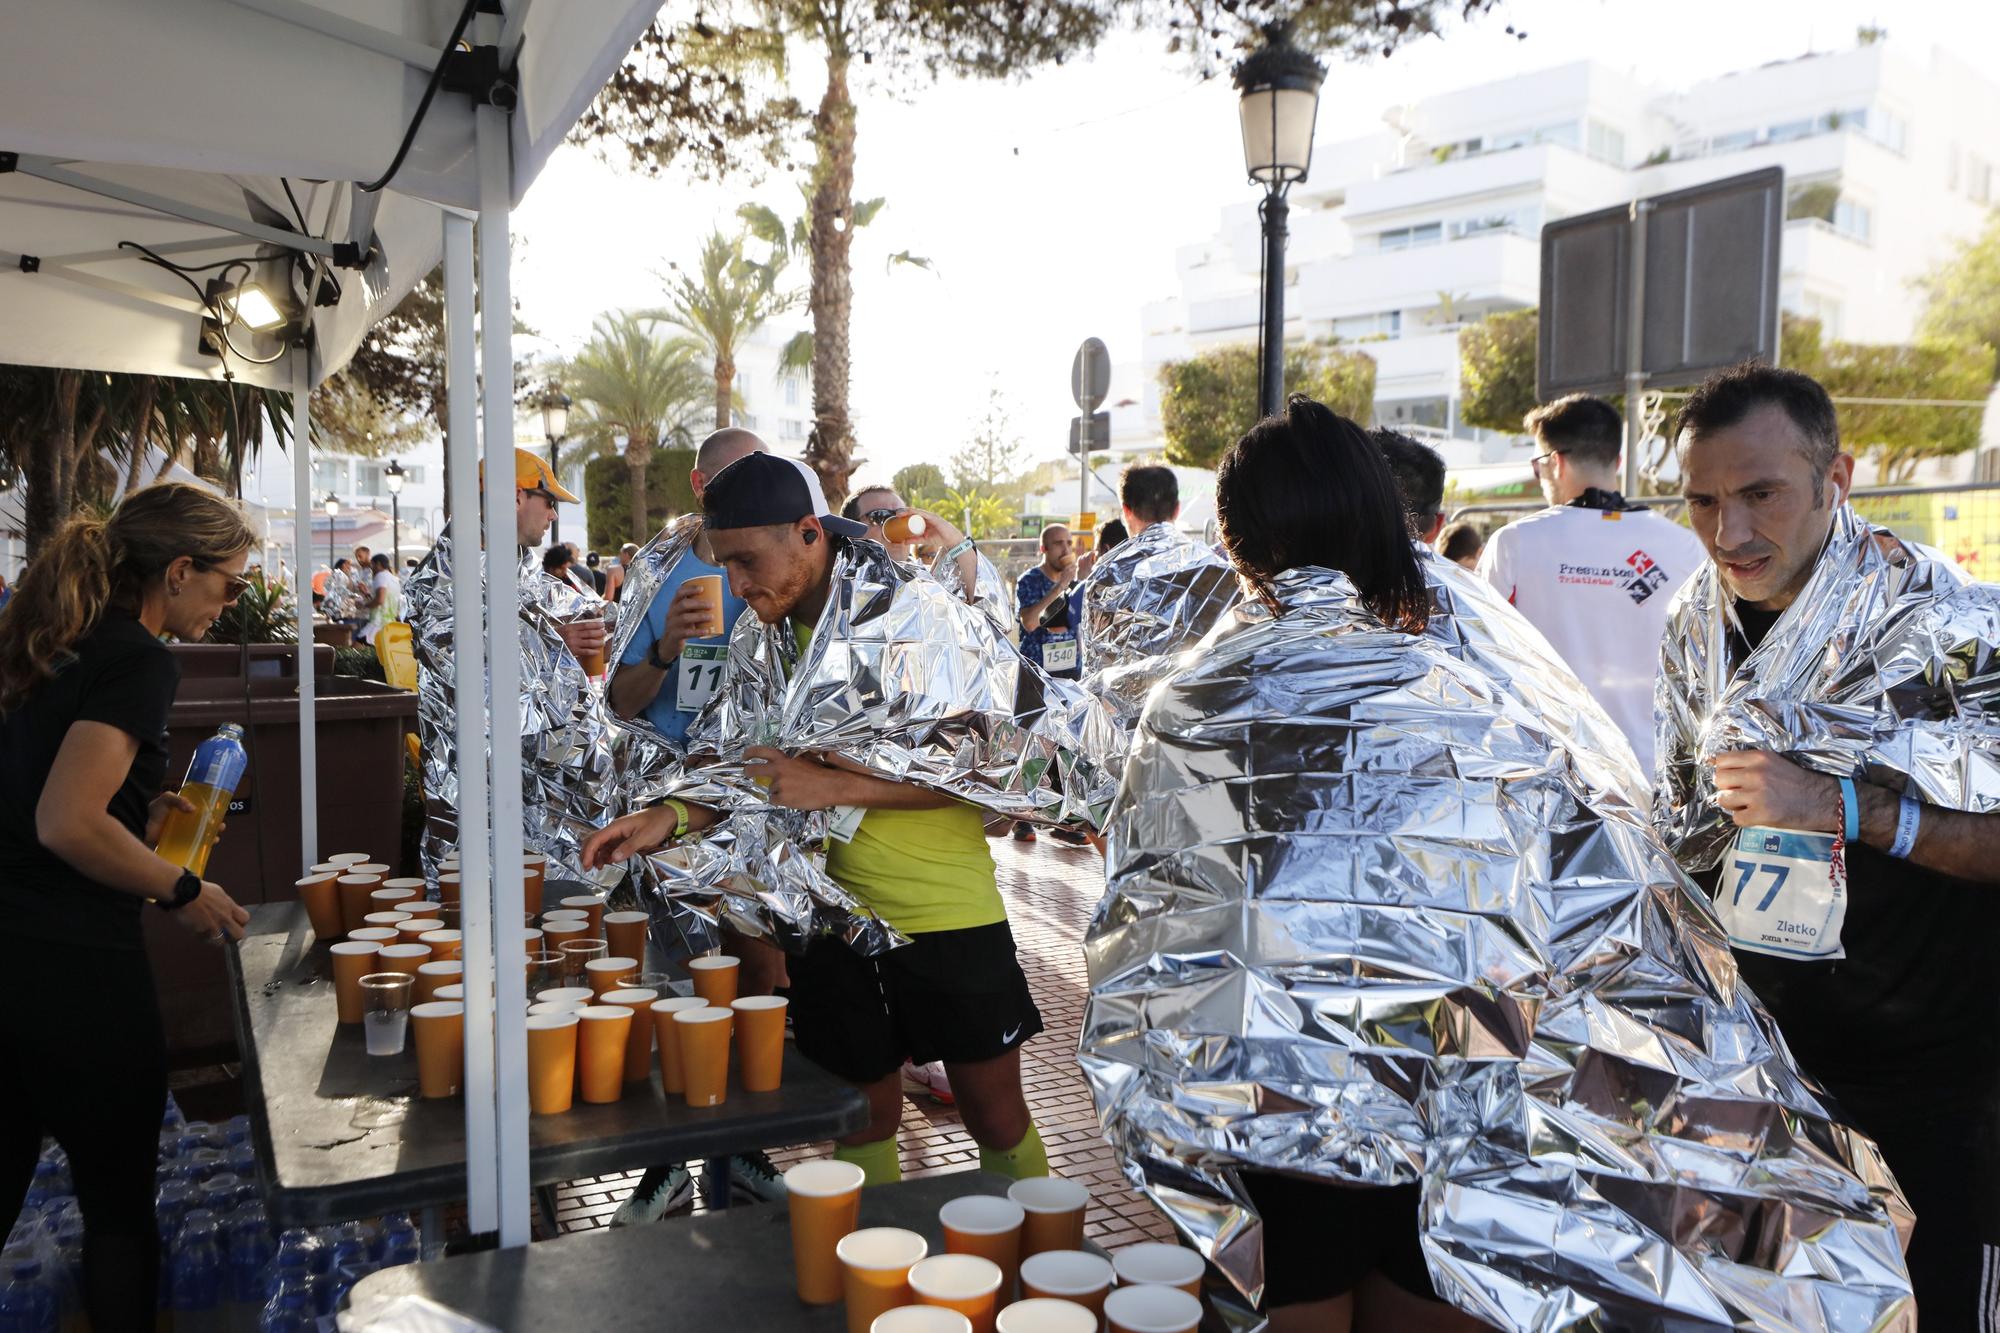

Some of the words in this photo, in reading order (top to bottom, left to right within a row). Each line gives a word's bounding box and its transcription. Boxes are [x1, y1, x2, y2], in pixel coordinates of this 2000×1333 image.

[1559, 563, 1634, 578] Presuntos
[1046, 649, 1072, 663] 1540
[1733, 860, 1790, 912] 77
[1776, 920, 1817, 936] Zlatko
